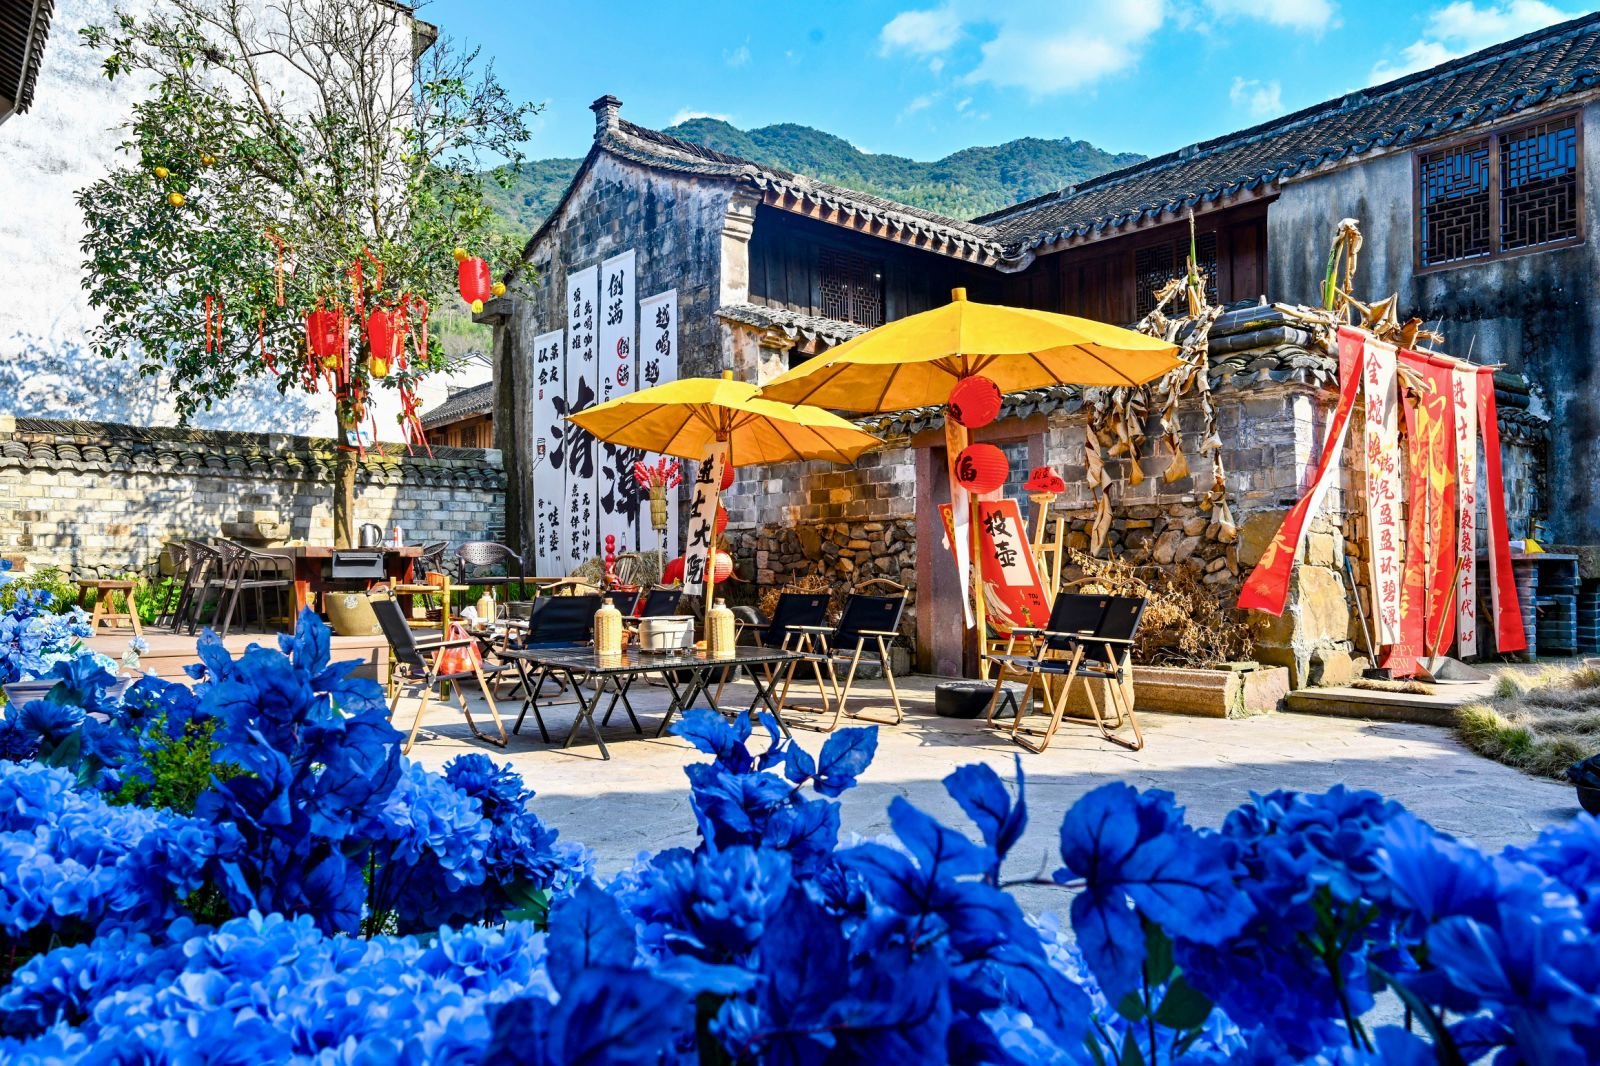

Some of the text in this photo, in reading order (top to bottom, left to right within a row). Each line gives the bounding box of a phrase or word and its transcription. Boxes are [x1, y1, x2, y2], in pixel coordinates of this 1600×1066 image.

[607, 269, 625, 326] 倒满
[583, 299, 593, 362] 先喝咖啡
[656, 303, 671, 356] 越喝
[618, 336, 629, 385] 倒满
[645, 358, 660, 388] 越
[955, 451, 977, 482] 福
[984, 510, 1017, 568] 投壶
[1392, 644, 1415, 656] PPY
